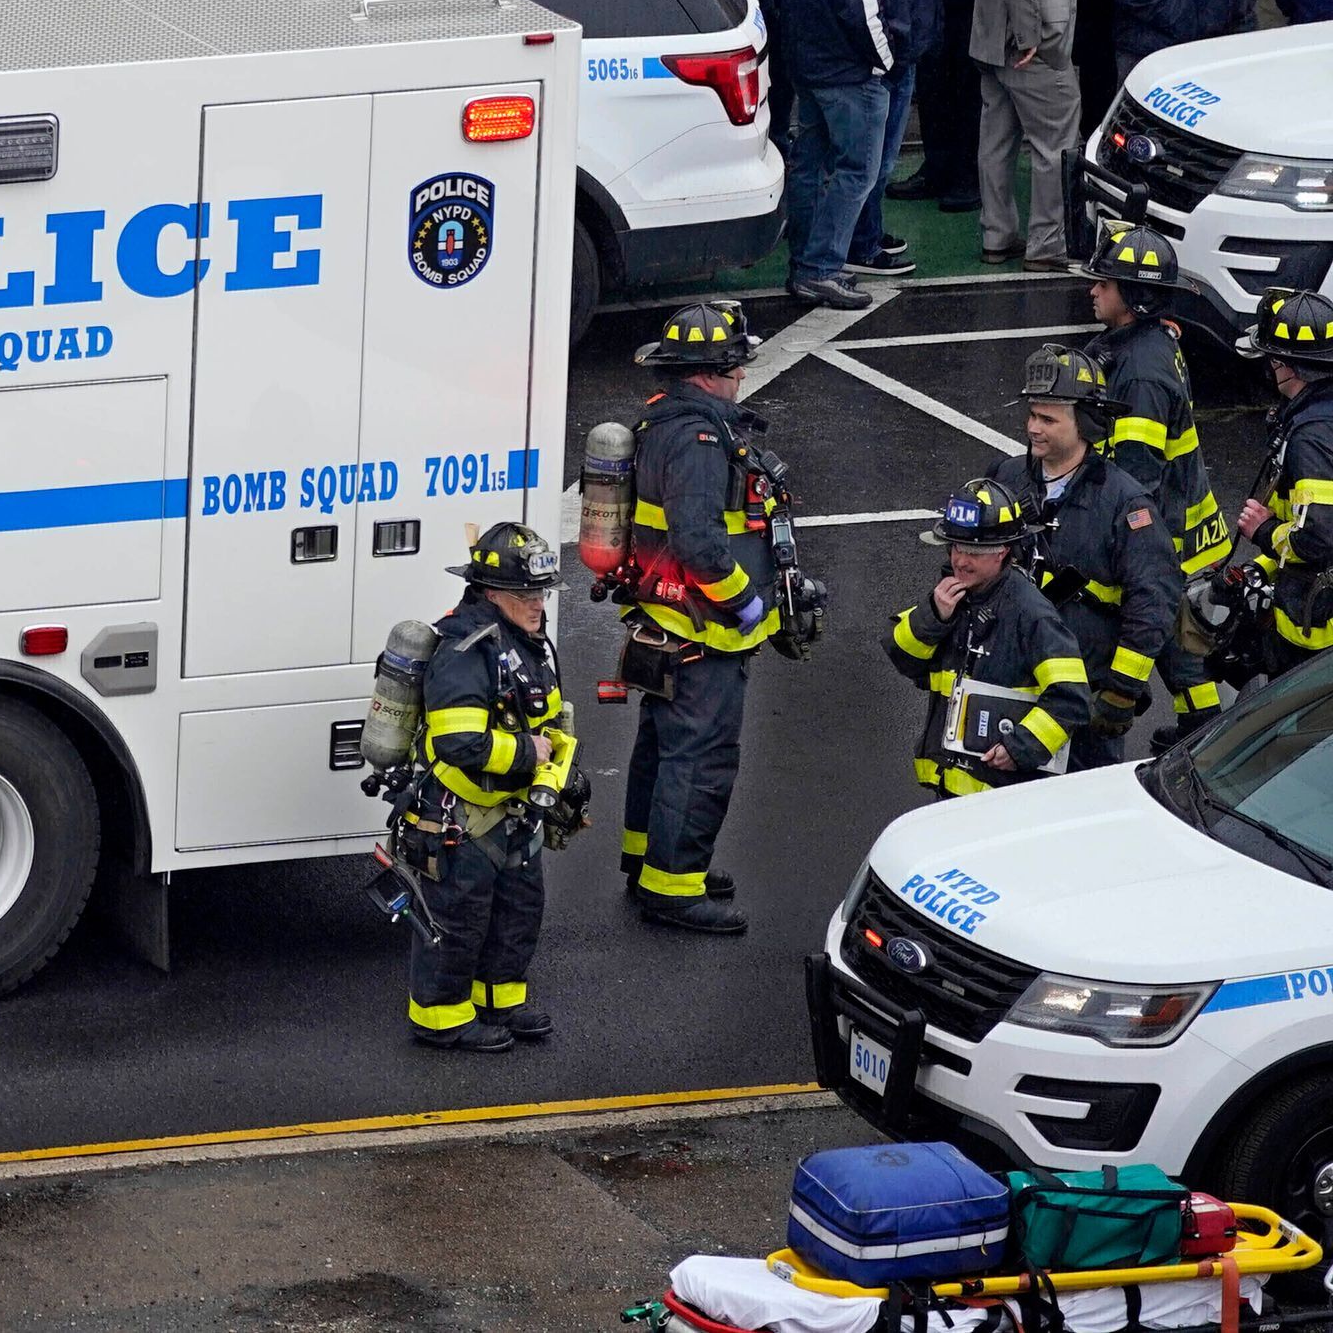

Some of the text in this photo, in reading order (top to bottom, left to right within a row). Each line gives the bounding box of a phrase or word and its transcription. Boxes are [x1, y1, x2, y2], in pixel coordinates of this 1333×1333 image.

[587, 57, 630, 82] 5065
[1141, 87, 1209, 129] POLICE
[1171, 81, 1222, 107] NYPD
[415, 177, 490, 213] POLICE
[431, 204, 472, 224] NYPD
[413, 247, 487, 285] BOMB SQUAD
[440, 257, 459, 267] 1903
[201, 454, 492, 517] BOMB SQUAD 7091
[590, 510, 620, 519] SCOTT
[899, 873, 988, 936] POLICE
[934, 866, 1002, 907] NYPD
[854, 1043, 887, 1085] 5010
